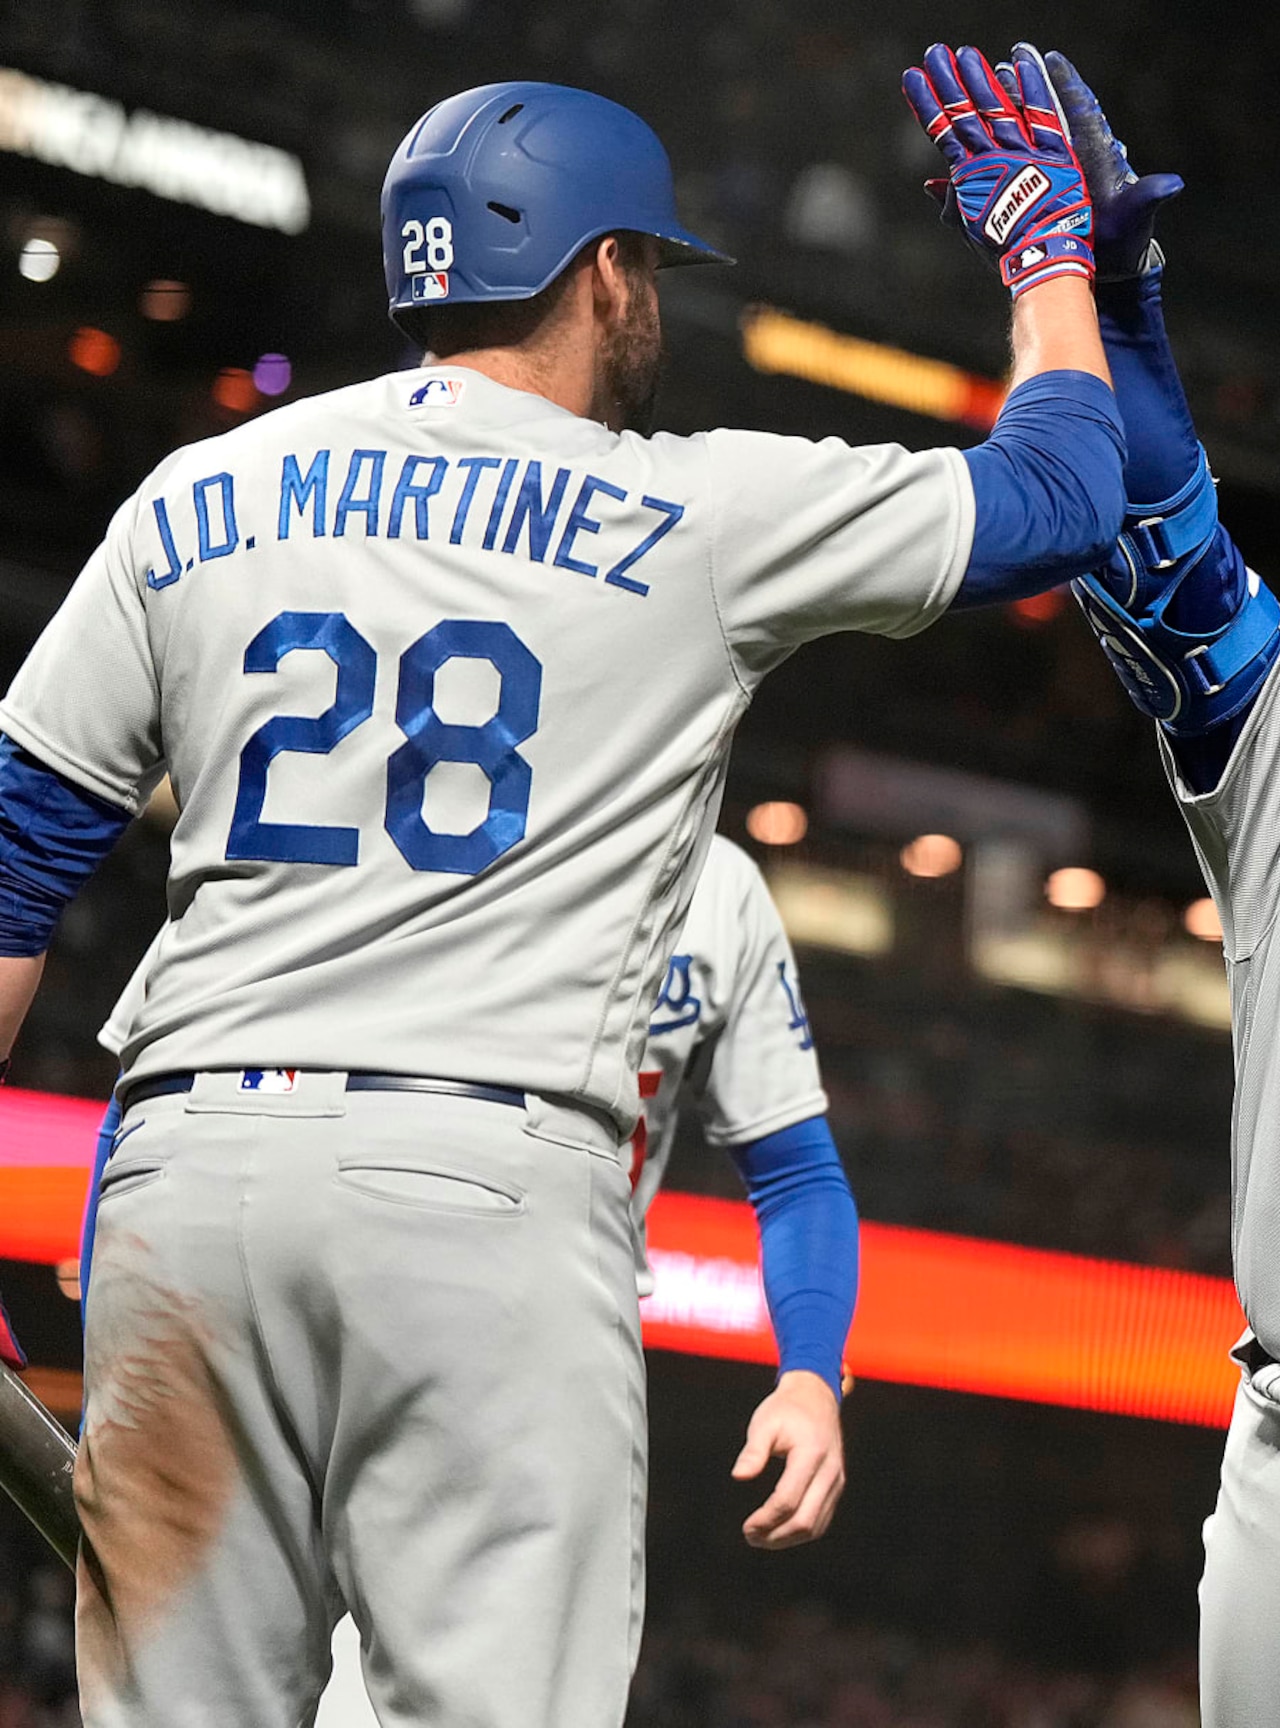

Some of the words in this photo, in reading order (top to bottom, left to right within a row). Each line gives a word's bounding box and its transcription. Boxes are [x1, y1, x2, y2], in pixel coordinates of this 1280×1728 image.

[402, 217, 453, 273] 28
[147, 471, 256, 591] J.D.
[277, 449, 685, 597] MARTINEZ
[225, 610, 543, 876] 28
